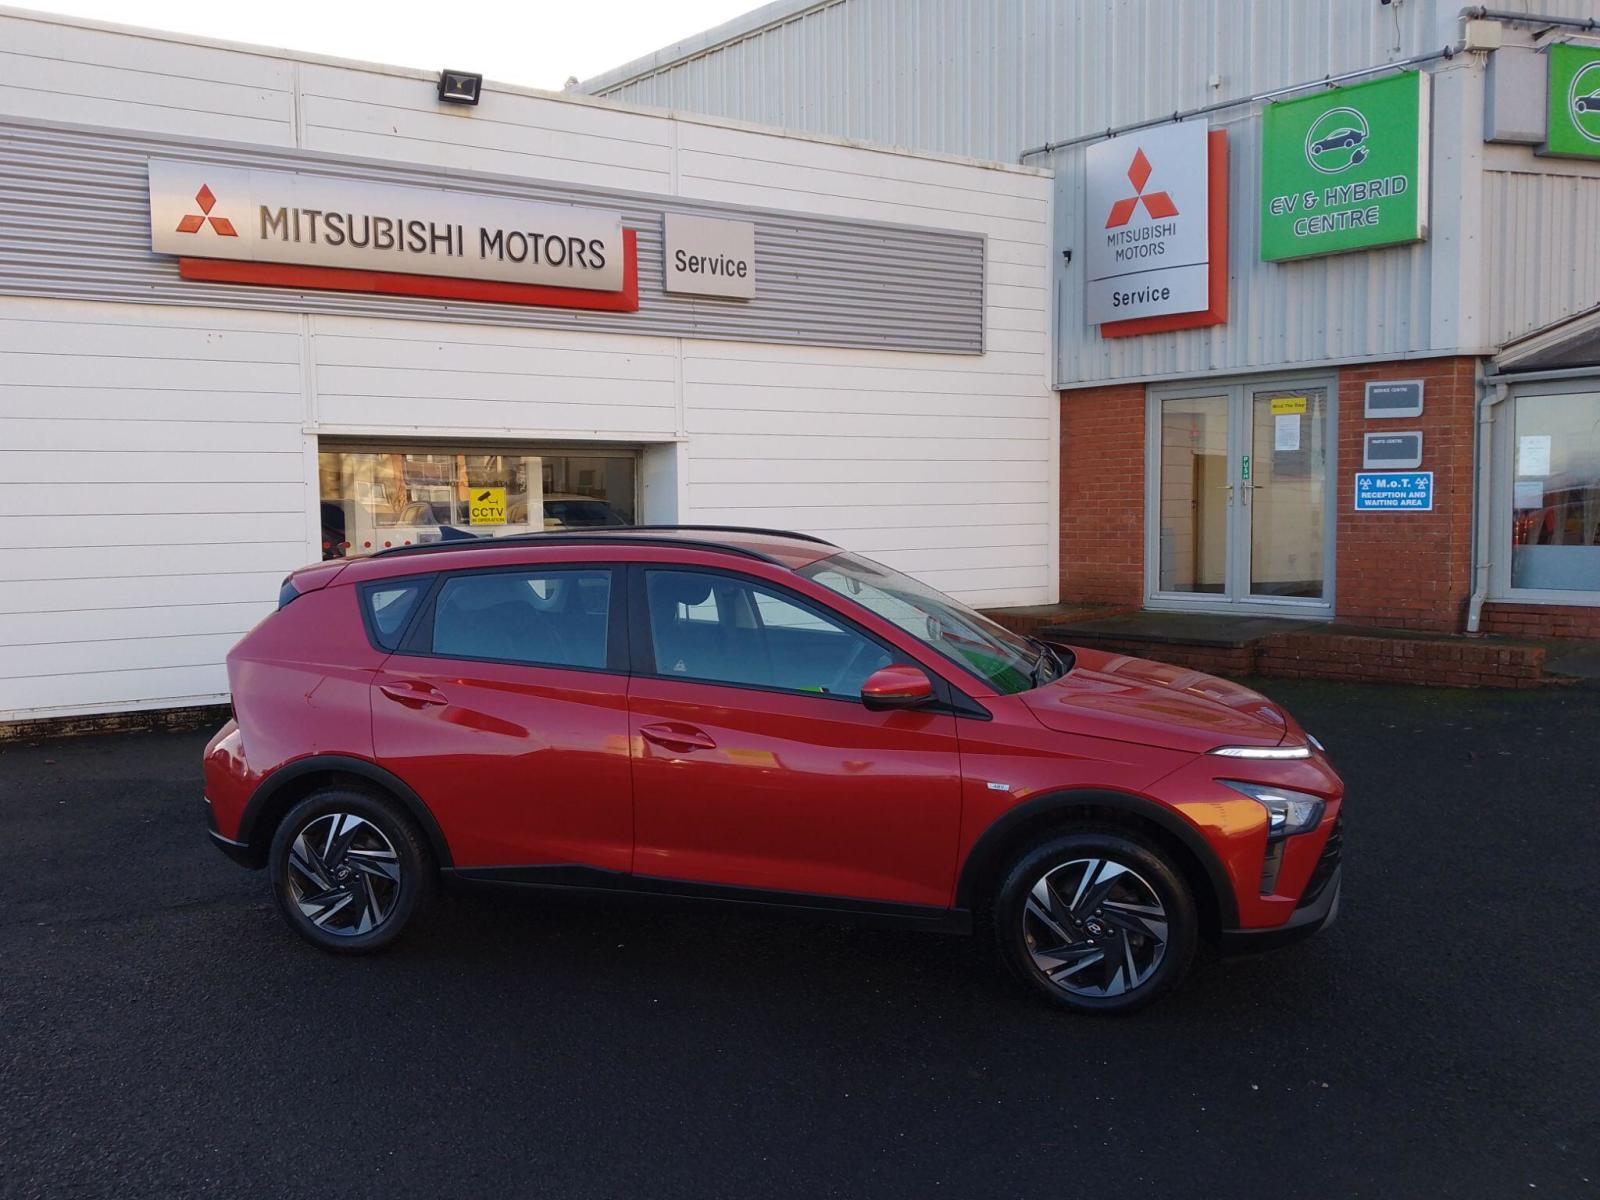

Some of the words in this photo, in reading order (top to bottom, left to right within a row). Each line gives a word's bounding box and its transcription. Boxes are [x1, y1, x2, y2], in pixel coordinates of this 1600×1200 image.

[1270, 194, 1298, 215] EV
[1303, 191, 1318, 210] &
[1325, 175, 1408, 206] HYBRID
[1294, 205, 1379, 236] CENTRE
[260, 205, 463, 257] MITSUBISHI
[479, 227, 605, 269] MOTORS
[1107, 222, 1176, 248] MITSUBISHI
[1115, 241, 1165, 262] MOTORS
[675, 249, 747, 278] Service
[1113, 286, 1170, 307] Service
[1361, 491, 1407, 499] RECEPTION
[1376, 479, 1411, 488] M.o.T.
[471, 507, 504, 518] CCTV
